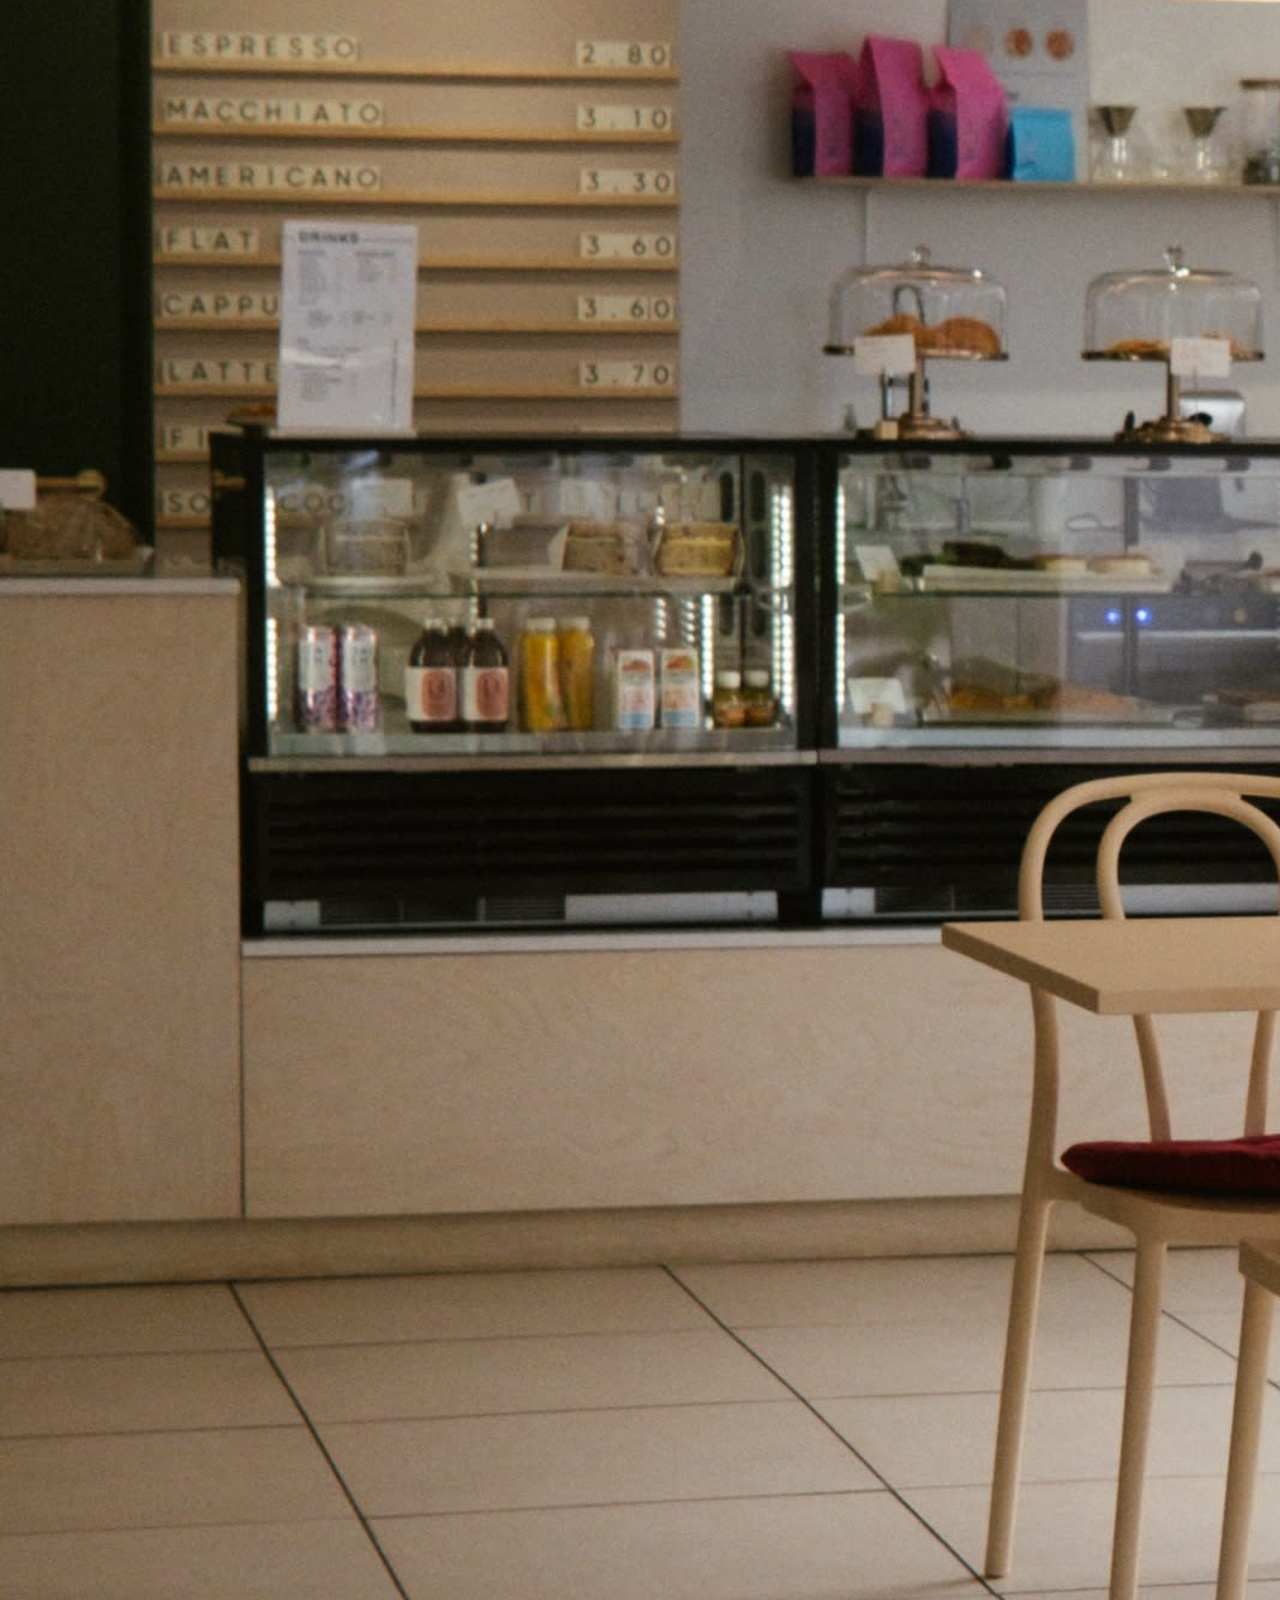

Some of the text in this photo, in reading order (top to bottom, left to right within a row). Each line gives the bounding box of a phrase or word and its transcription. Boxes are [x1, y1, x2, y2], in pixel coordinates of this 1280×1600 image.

[167, 35, 354, 59] ESPRESSO
[582, 43, 667, 65] 2.80
[166, 101, 380, 122] MACCHIATO
[583, 107, 668, 129] 3.10
[166, 165, 379, 187] AMERICANO
[586, 171, 671, 193] 3.30
[166, 228, 255, 250] FLAT
[587, 235, 671, 257] 3.60
[584, 298, 670, 320] 3.60
[585, 365, 670, 386] 3.70
